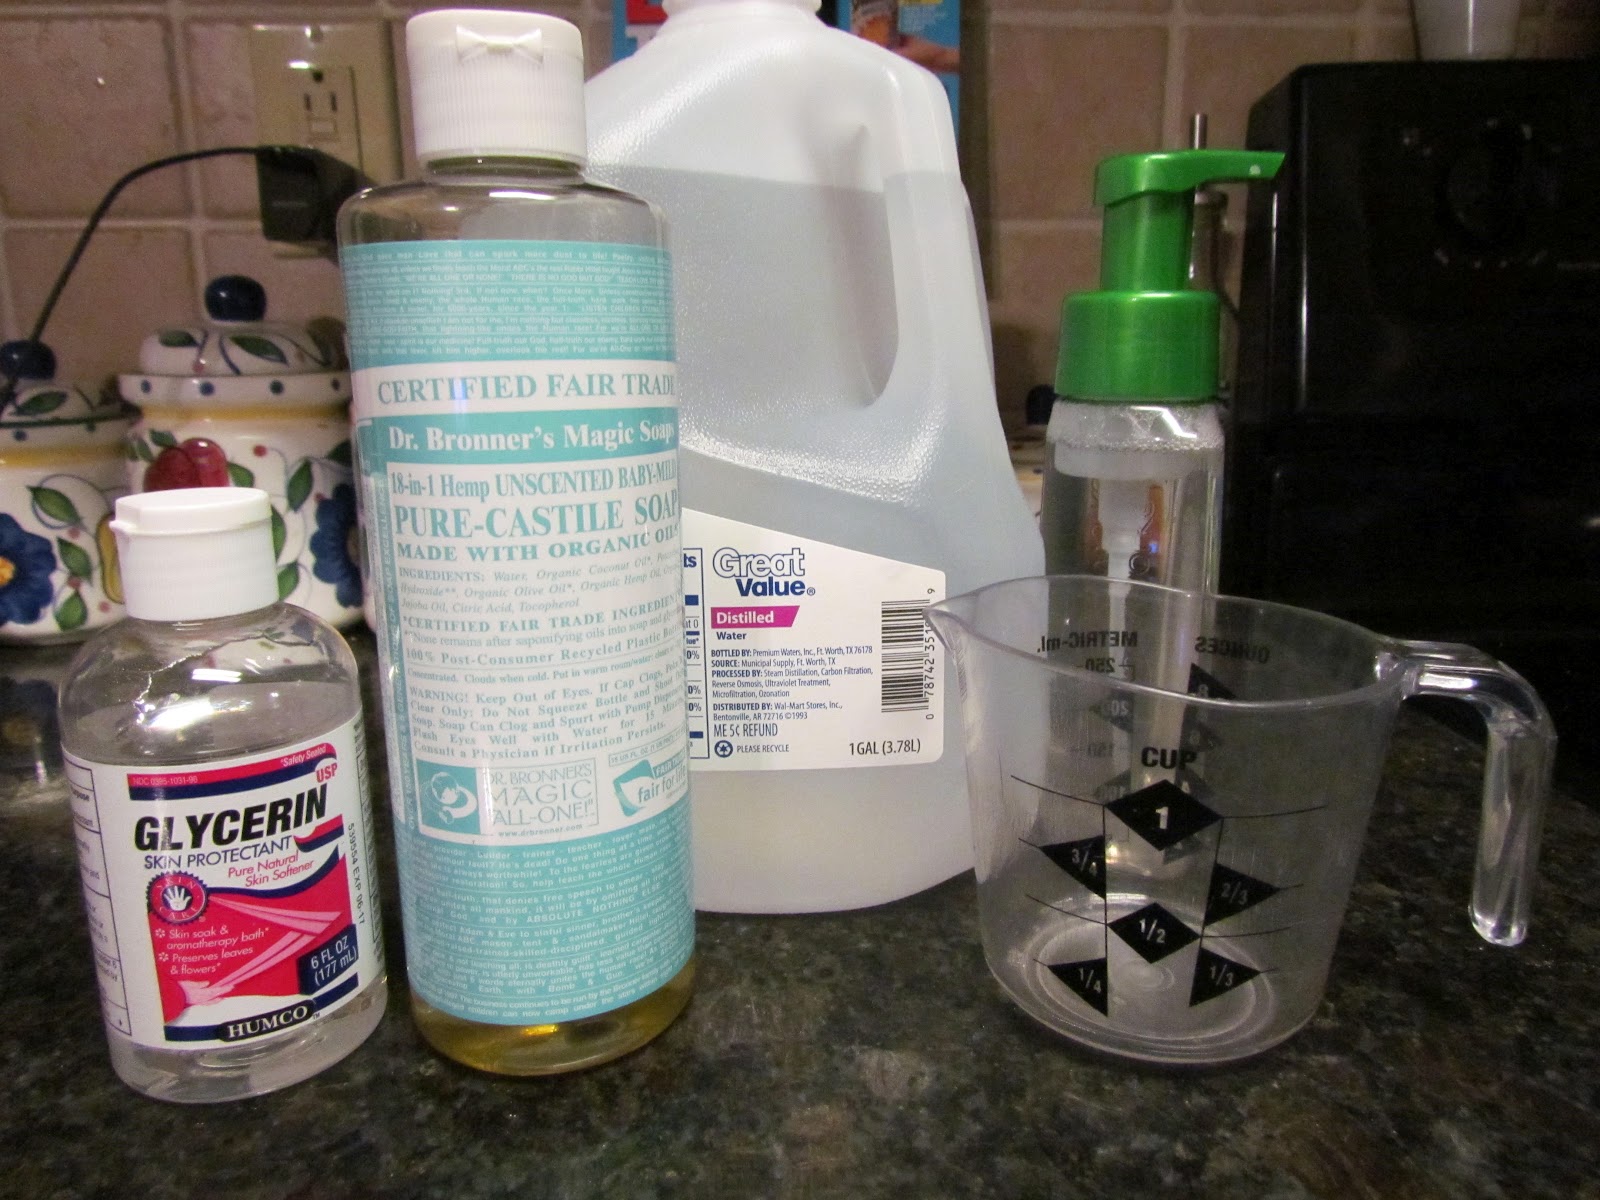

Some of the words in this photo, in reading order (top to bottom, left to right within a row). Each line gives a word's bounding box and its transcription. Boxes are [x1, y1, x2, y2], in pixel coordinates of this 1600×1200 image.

[377, 374, 537, 405] CERTIFIED
[546, 373, 616, 398] FAIR
[388, 426, 418, 450] Dr.
[426, 426, 554, 451] Bronner's
[563, 423, 634, 451] Magic
[391, 472, 434, 497] 18-in-1
[441, 473, 490, 502] Hemp
[495, 467, 614, 498] UNSCENTED
[394, 500, 624, 538] PURE-CASTILE
[634, 488, 678, 526] SOAP
[397, 541, 458, 562] MADE
[467, 543, 539, 562] WITH
[549, 532, 651, 558] ORGANIC
[400, 567, 485, 582] INGREDIENTS:
[536, 569, 581, 581] Organic
[713, 547, 805, 579] Great
[500, 620, 540, 632] FAIR
[549, 611, 605, 629] TRADE
[716, 610, 775, 626] Distilled
[716, 631, 748, 641] Water
[561, 642, 622, 661] Recycled
[711, 649, 740, 658] BOTTLED
[741, 649, 752, 657] BY:
[753, 648, 780, 657] Premium
[780, 647, 803, 657] Waters,
[816, 646, 825, 655] Ft.
[825, 645, 845, 656] Worth,
[846, 646, 854, 654] TX
[854, 645, 873, 655] 76178
[711, 659, 740, 668] SOURCE:
[741, 658, 772, 669] Municipal
[772, 658, 796, 669] Supply,
[797, 659, 805, 667] Ft.
[805, 658, 827, 667] Worth,
[828, 657, 836, 665] TX
[712, 670, 750, 678] PROCESSED
[764, 668, 784, 677] Steam
[784, 667, 819, 678] Distillation,
[821, 667, 843, 676] Carbon
[844, 666, 873, 676] Filtration,
[712, 680, 736, 688] Reverse
[737, 679, 764, 688] Osmosis,
[765, 678, 798, 688] Ultraviolet
[798, 678, 831, 687] Treatment,
[924, 658, 935, 698] 78742
[476, 693, 507, 706] Keep
[513, 693, 538, 703] Out
[614, 679, 635, 690] Cap
[712, 690, 758, 699] Microfiltration,
[758, 689, 790, 698] Ozonation
[482, 708, 499, 718] Do
[507, 707, 530, 717] Not
[538, 702, 588, 716] Squeeze
[596, 693, 628, 708] Bottle
[713, 702, 760, 711] DISTRIBUTED
[761, 702, 773, 711] BY:
[774, 702, 804, 711] Wal-Mart
[806, 702, 828, 711] Stores,
[713, 712, 752, 721] Bentonville,
[763, 712, 784, 720] 72716
[449, 734, 476, 745] Eyes
[489, 735, 517, 745] Well
[573, 726, 608, 738] Water
[620, 719, 636, 730] for
[470, 721, 494, 732] Can
[499, 721, 528, 733] Clog
[560, 713, 593, 728] Spurt
[714, 724, 727, 738] ME
[743, 723, 778, 737] REFUND
[472, 748, 539, 761] Physician
[561, 736, 623, 754] Irritation
[737, 745, 761, 753] PLEASE
[762, 744, 790, 753] RECYCLE
[882, 738, 921, 756] (3.78L)
[1141, 747, 1198, 770] CUP
[316, 762, 338, 783] USP
[510, 763, 593, 786] BRONNER'S
[490, 778, 593, 806] MAGIC
[638, 782, 660, 803] fair
[662, 774, 674, 792] for
[134, 783, 328, 852] GLYCERIN
[1155, 806, 1170, 830] 1
[144, 854, 183, 870] SKIN
[187, 835, 293, 868] PROTECTANT
[1072, 848, 1098, 878] 3/4
[228, 865, 255, 879] Pure
[257, 850, 300, 871] Natural
[245, 872, 270, 888] Skin
[273, 858, 315, 882] Softener
[157, 876, 197, 890] SKIN
[353, 866, 362, 891] EXP
[1222, 881, 1249, 906] 2/3
[159, 908, 197, 923] CARE
[166, 934, 239, 951] aromatherapy
[169, 928, 190, 940] Skin
[192, 926, 218, 938] soak
[220, 924, 229, 935] &
[1139, 918, 1166, 945] 1/2
[172, 952, 218, 964] Preserves
[221, 946, 254, 960] leaves
[311, 955, 318, 970] 6
[321, 949, 334, 964] FL
[335, 939, 349, 956] OZ
[170, 965, 179, 975] &
[314, 962, 334, 986] (177
[336, 950, 358, 974] mL)
[1210, 964, 1235, 987] 1/3
[1078, 968, 1102, 993] 1/4
[227, 1004, 308, 1038] HUMCO
